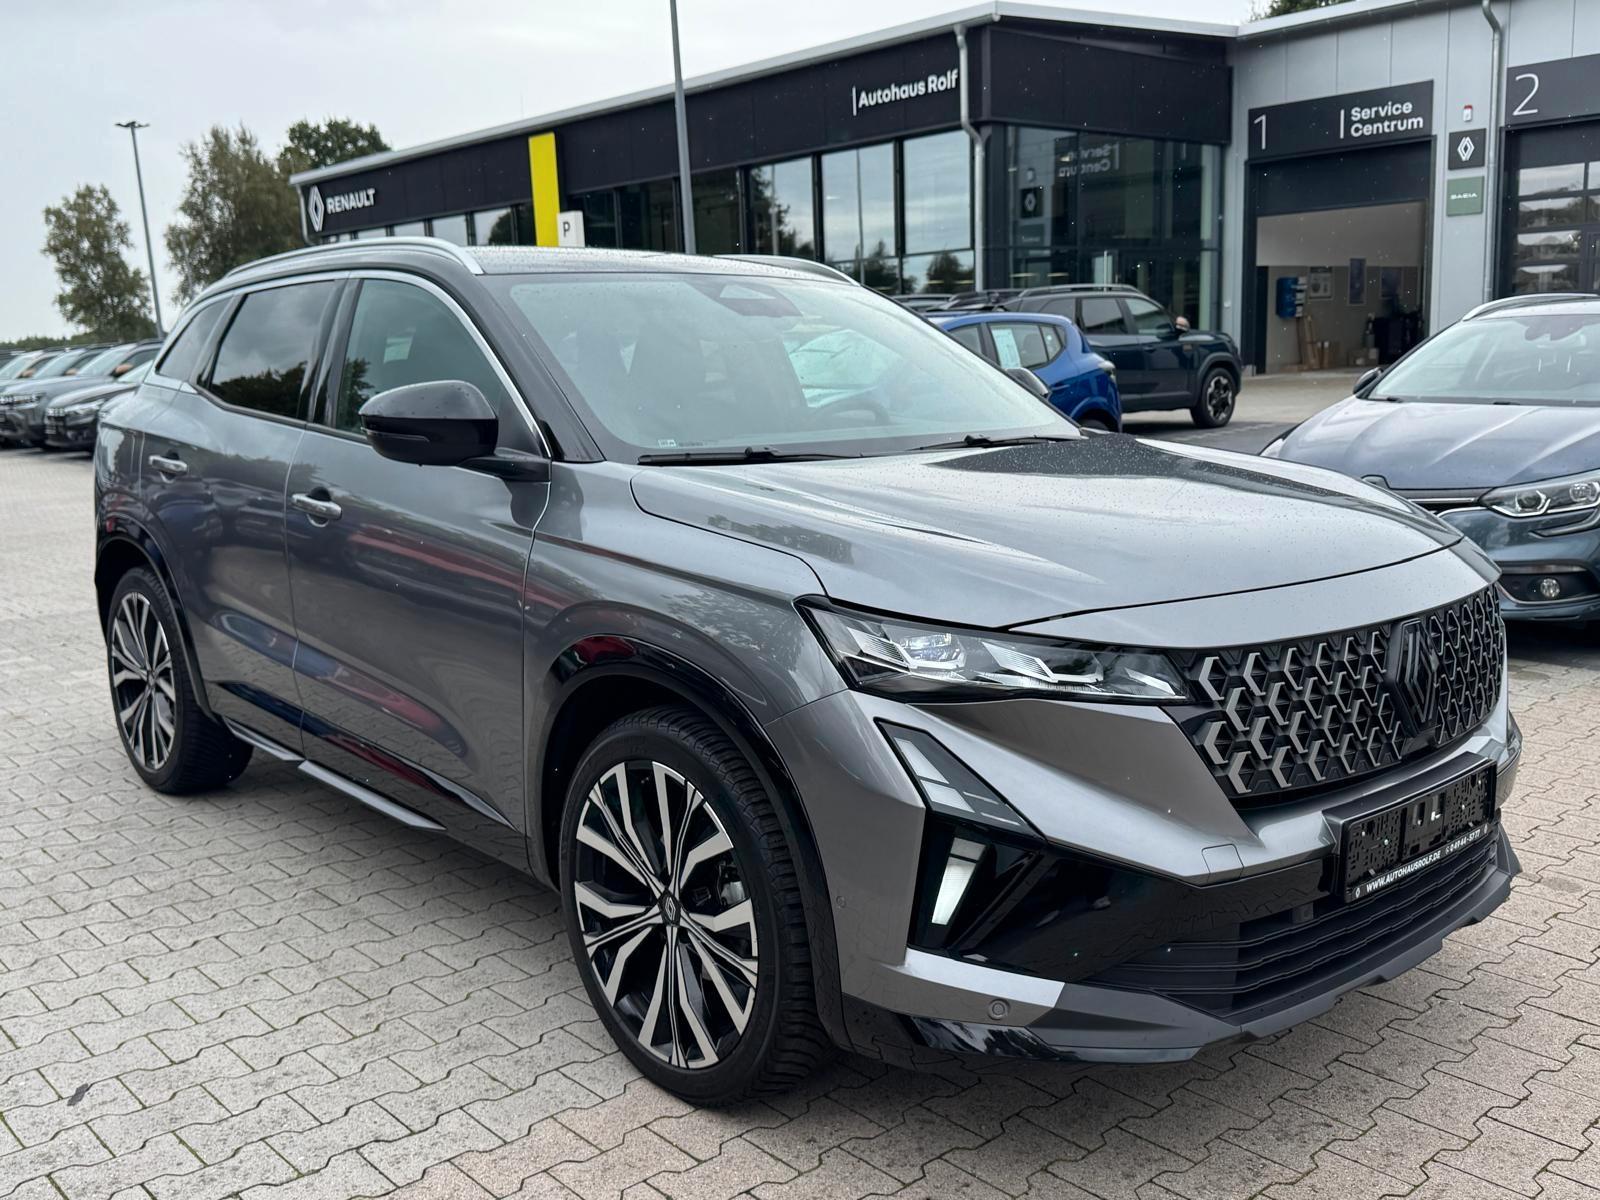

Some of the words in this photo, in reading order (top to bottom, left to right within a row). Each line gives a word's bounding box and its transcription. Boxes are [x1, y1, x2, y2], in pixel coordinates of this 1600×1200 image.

[858, 83, 926, 108] Autohaus
[927, 69, 958, 93] Rolf
[1512, 73, 1539, 116] 2
[1350, 101, 1413, 121] Service
[1253, 114, 1267, 150] 1
[1350, 116, 1424, 137] Centrum
[325, 188, 376, 214] RENAULT
[563, 221, 571, 237] P
